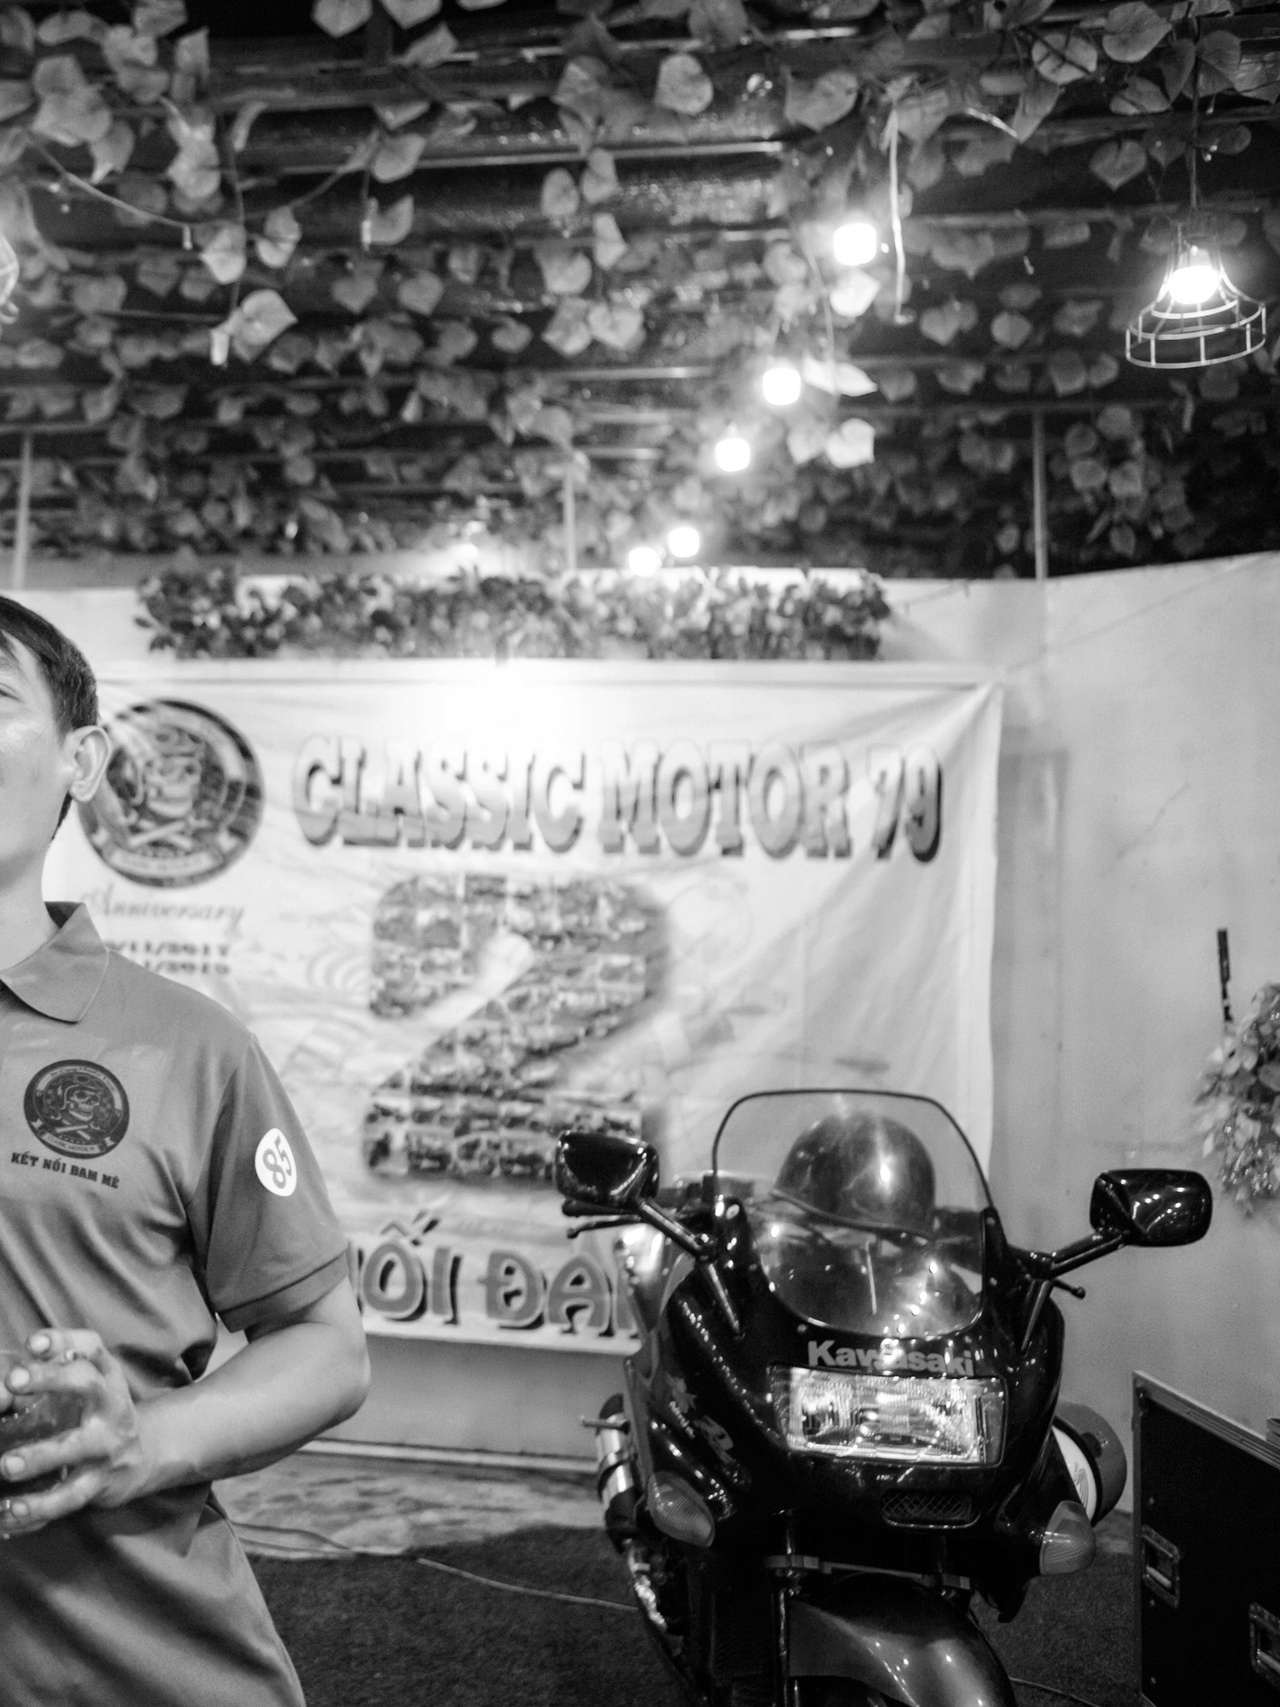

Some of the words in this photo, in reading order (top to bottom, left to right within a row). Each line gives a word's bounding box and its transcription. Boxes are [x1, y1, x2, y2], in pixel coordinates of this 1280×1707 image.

[293, 736, 585, 853] CLASSIC
[599, 739, 852, 860] MOTOR
[867, 744, 942, 862] 79
[10, 1150, 39, 1167] KẾT
[42, 1157, 66, 1173] NỐI
[263, 1135, 292, 1189] 85
[347, 1209, 460, 1325] ỐI
[807, 1340, 974, 1377] Kawasaki
